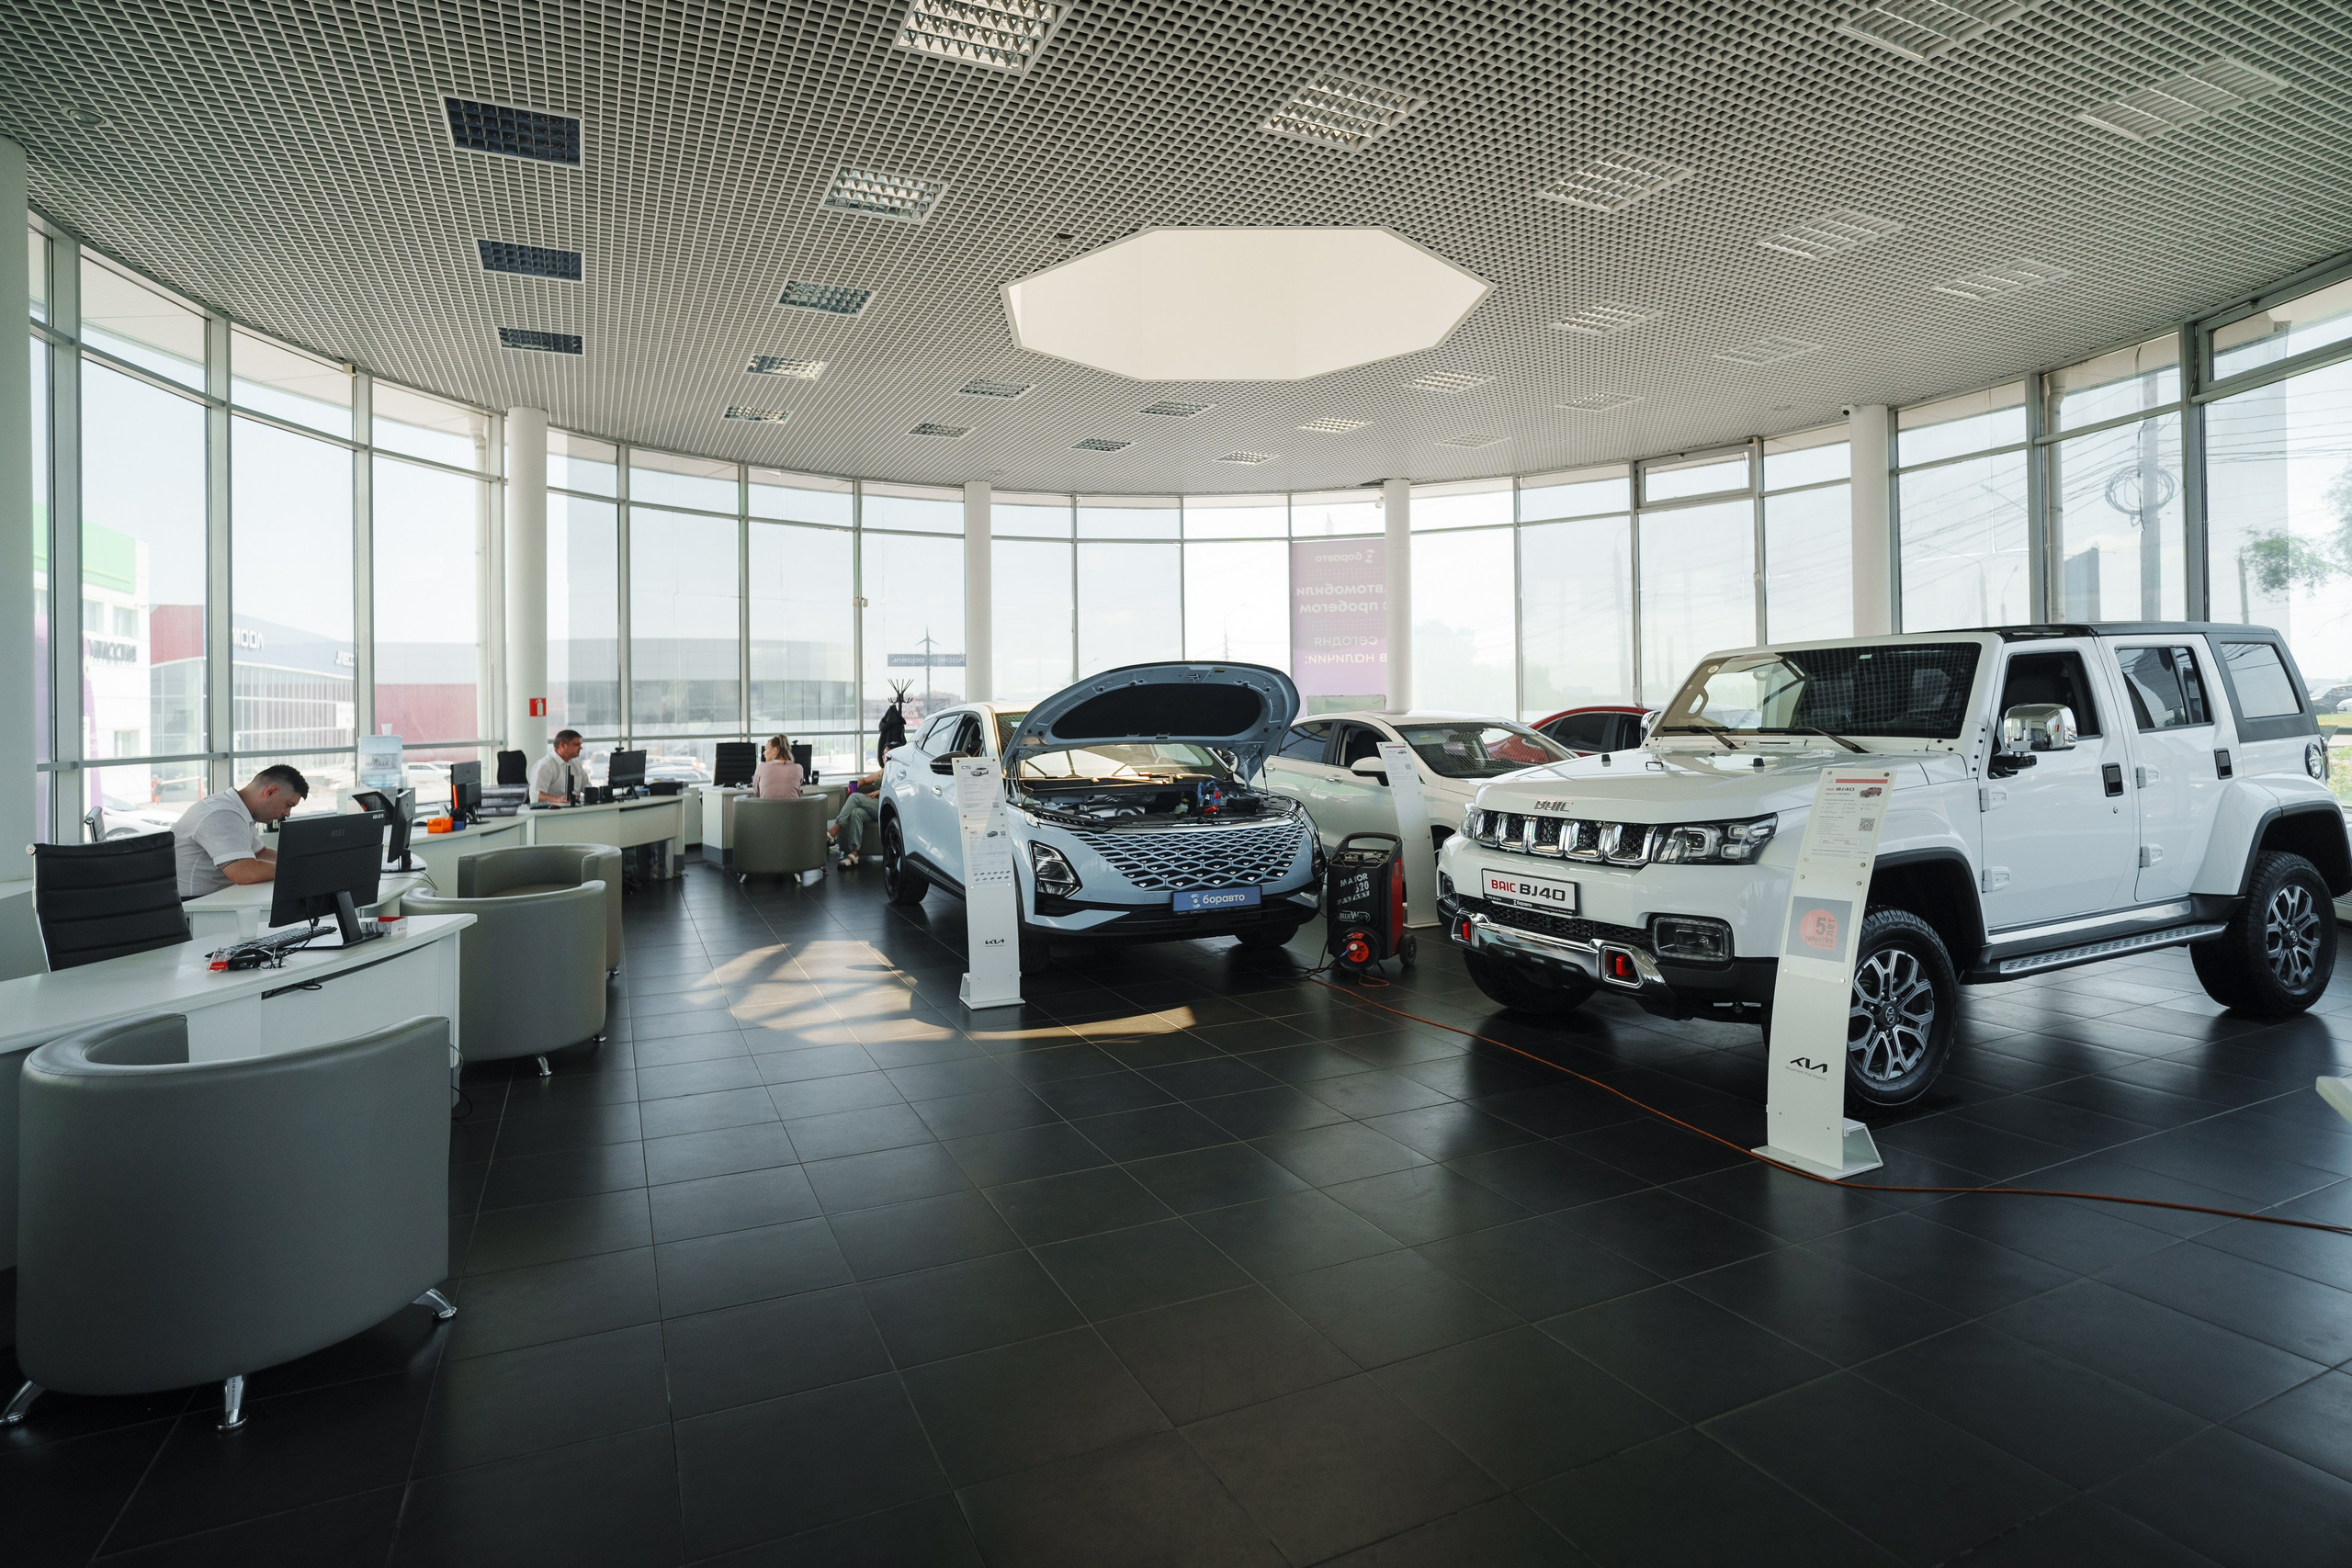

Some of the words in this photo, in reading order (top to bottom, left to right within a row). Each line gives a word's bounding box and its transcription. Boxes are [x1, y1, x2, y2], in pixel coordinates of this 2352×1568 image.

[232, 626, 265, 650] MODA
[1533, 799, 1574, 813] BAIC
[1490, 879, 1517, 893] BAIC
[1519, 883, 1566, 901] BJ40
[1202, 894, 1246, 905] боравто
[1815, 917, 1826, 936] 5
[1826, 919, 1836, 937] лет
[1804, 935, 1834, 944] ГАРАНТИЯ
[1784, 1065, 1804, 1074] Movement
[1812, 1074, 1827, 1082] inspires
[1790, 1056, 1828, 1074] KIA
